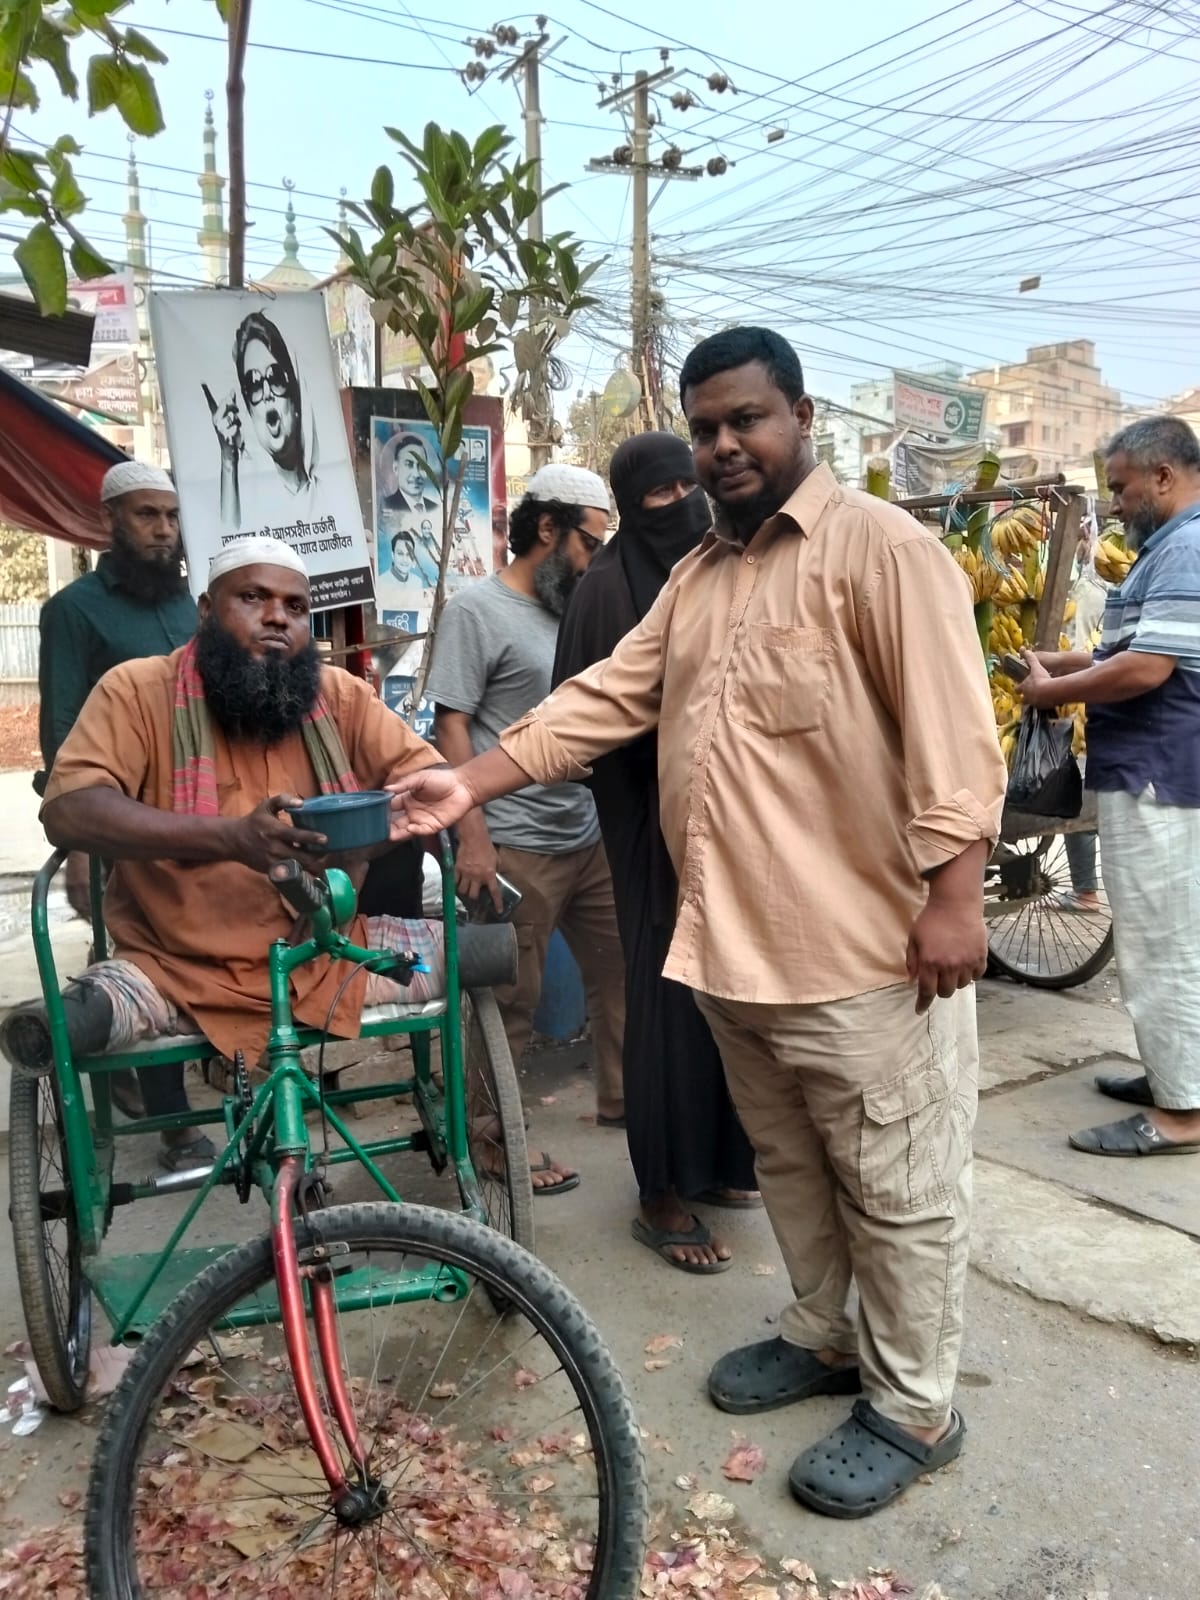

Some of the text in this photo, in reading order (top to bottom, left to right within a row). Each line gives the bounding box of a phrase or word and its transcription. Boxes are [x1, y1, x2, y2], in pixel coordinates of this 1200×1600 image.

[312, 515, 337, 534] তর্জনী
[299, 541, 318, 555] যাবে
[319, 532, 353, 552] আজীবন
